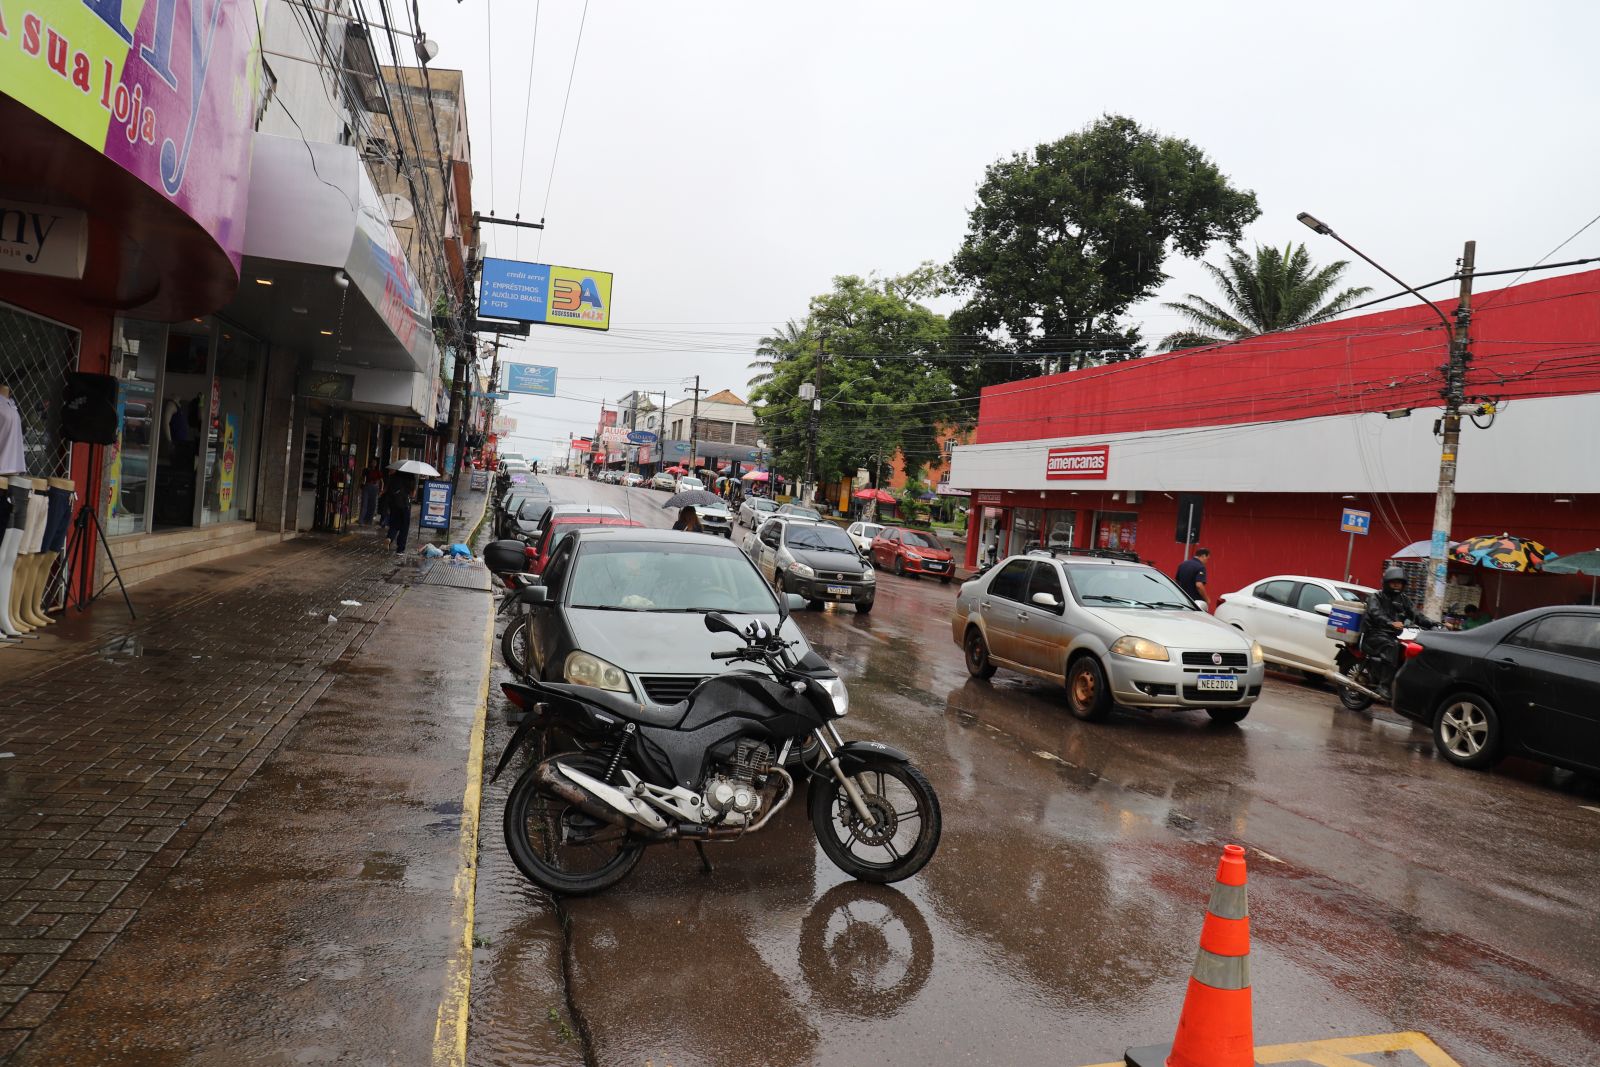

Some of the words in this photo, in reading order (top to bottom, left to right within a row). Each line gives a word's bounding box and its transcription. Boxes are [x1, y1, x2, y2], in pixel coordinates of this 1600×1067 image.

[23, 13, 91, 93] sua
[100, 59, 156, 144] loja
[492, 281, 539, 293] EMPRÉSTIMOS
[491, 290, 519, 300] AUXÍLIO
[520, 294, 543, 303] BRASIL
[491, 300, 508, 308] FGTS
[1048, 456, 1105, 470] americanas
